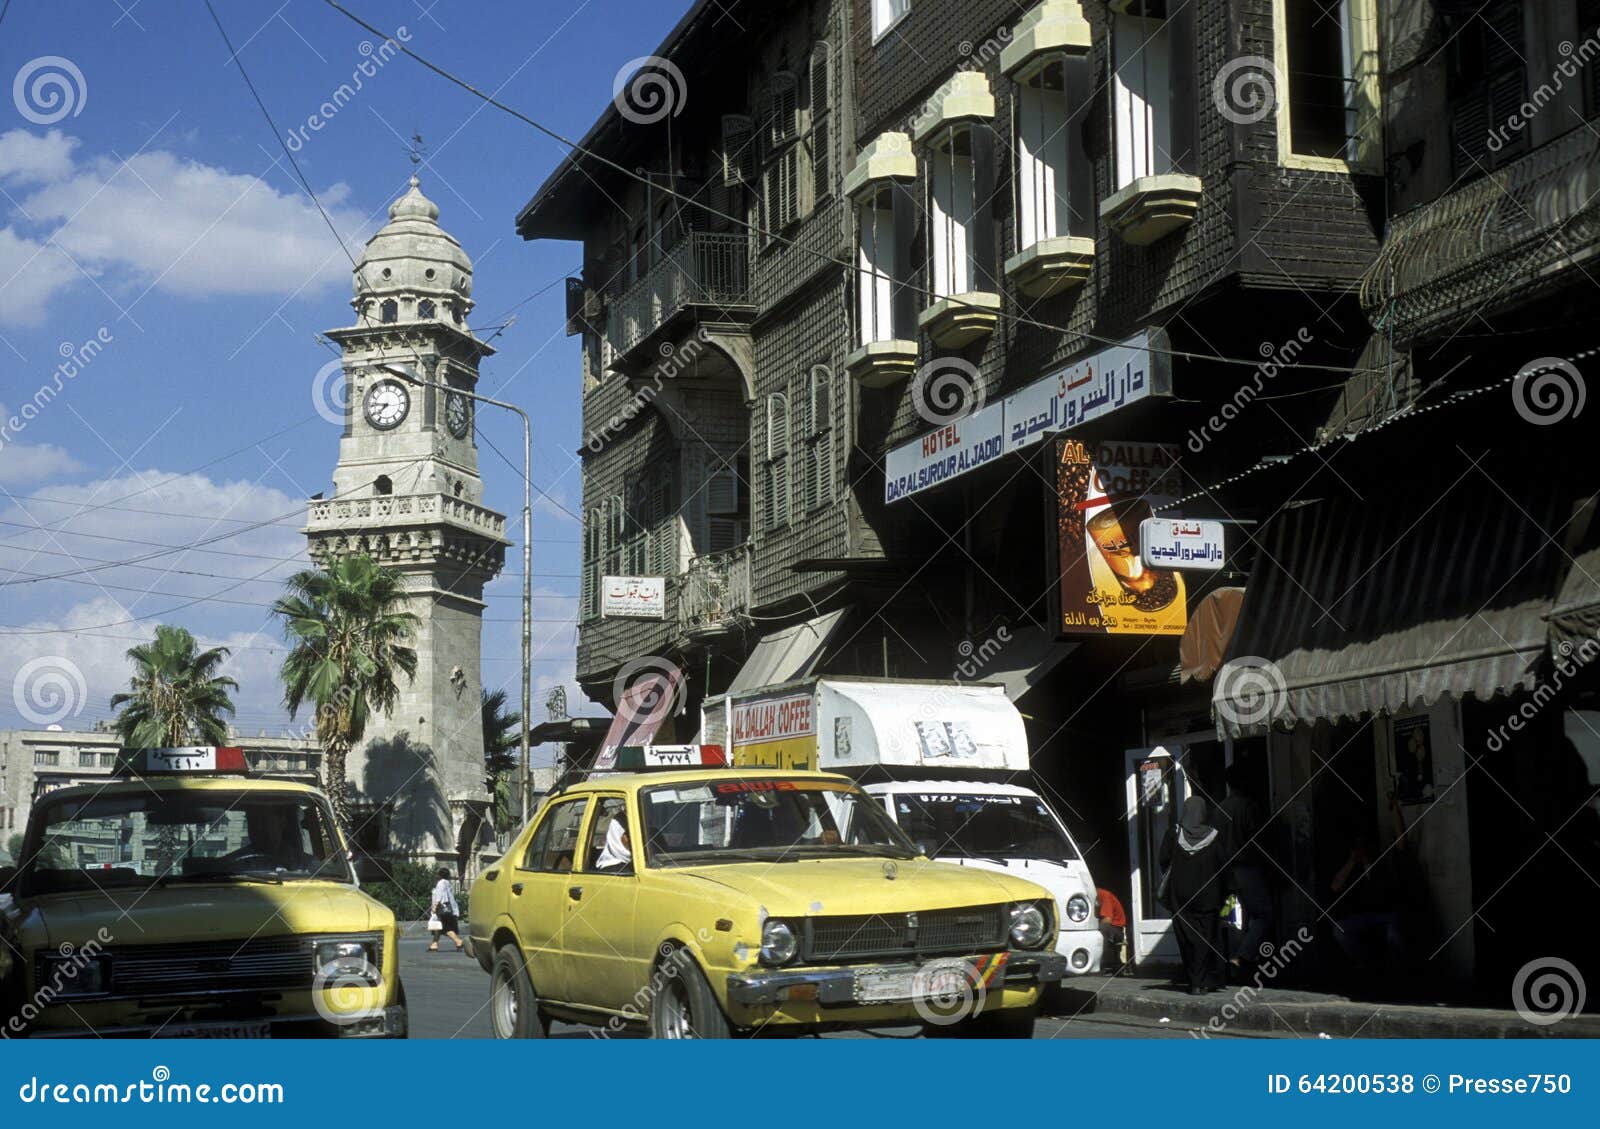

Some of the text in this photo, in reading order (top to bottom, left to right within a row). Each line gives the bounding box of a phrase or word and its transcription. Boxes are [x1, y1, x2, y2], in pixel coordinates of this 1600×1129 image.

[1058, 361, 1093, 399] فندق
[1114, 362, 1144, 408] دار
[922, 424, 960, 458] HOTEL
[971, 434, 1002, 467] JADID
[1061, 442, 1089, 464] AL
[1172, 522, 1201, 536] فندق
[735, 698, 811, 740] AL DALLAH COFFEE
